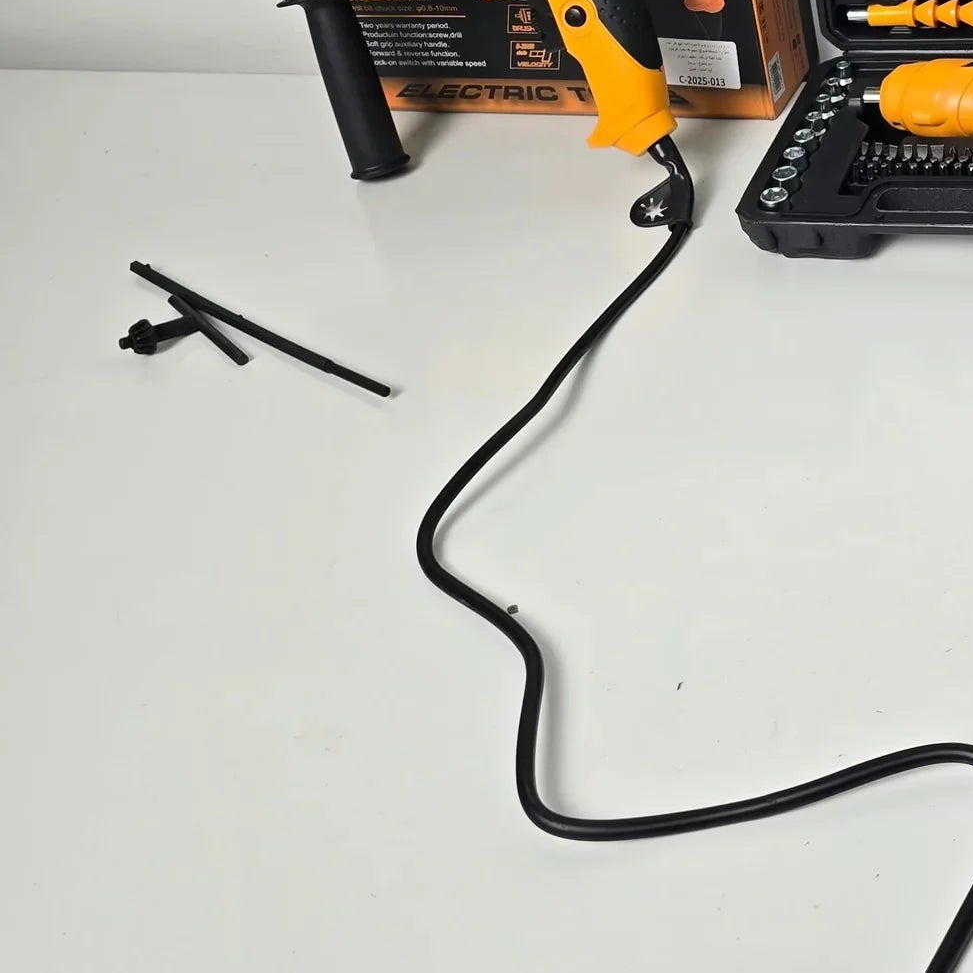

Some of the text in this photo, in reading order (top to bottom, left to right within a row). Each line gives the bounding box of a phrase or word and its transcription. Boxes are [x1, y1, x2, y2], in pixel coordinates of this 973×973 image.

[359, 21, 374, 29] Two
[396, 22, 425, 30] warranty
[426, 22, 451, 30] period.
[380, 41, 394, 49] grip
[394, 41, 422, 49] auxiliary
[421, 59, 436, 67] with
[465, 60, 487, 68] speed
[679, 75, 726, 87] C-2025-013
[396, 83, 559, 103] ELECTRIC
